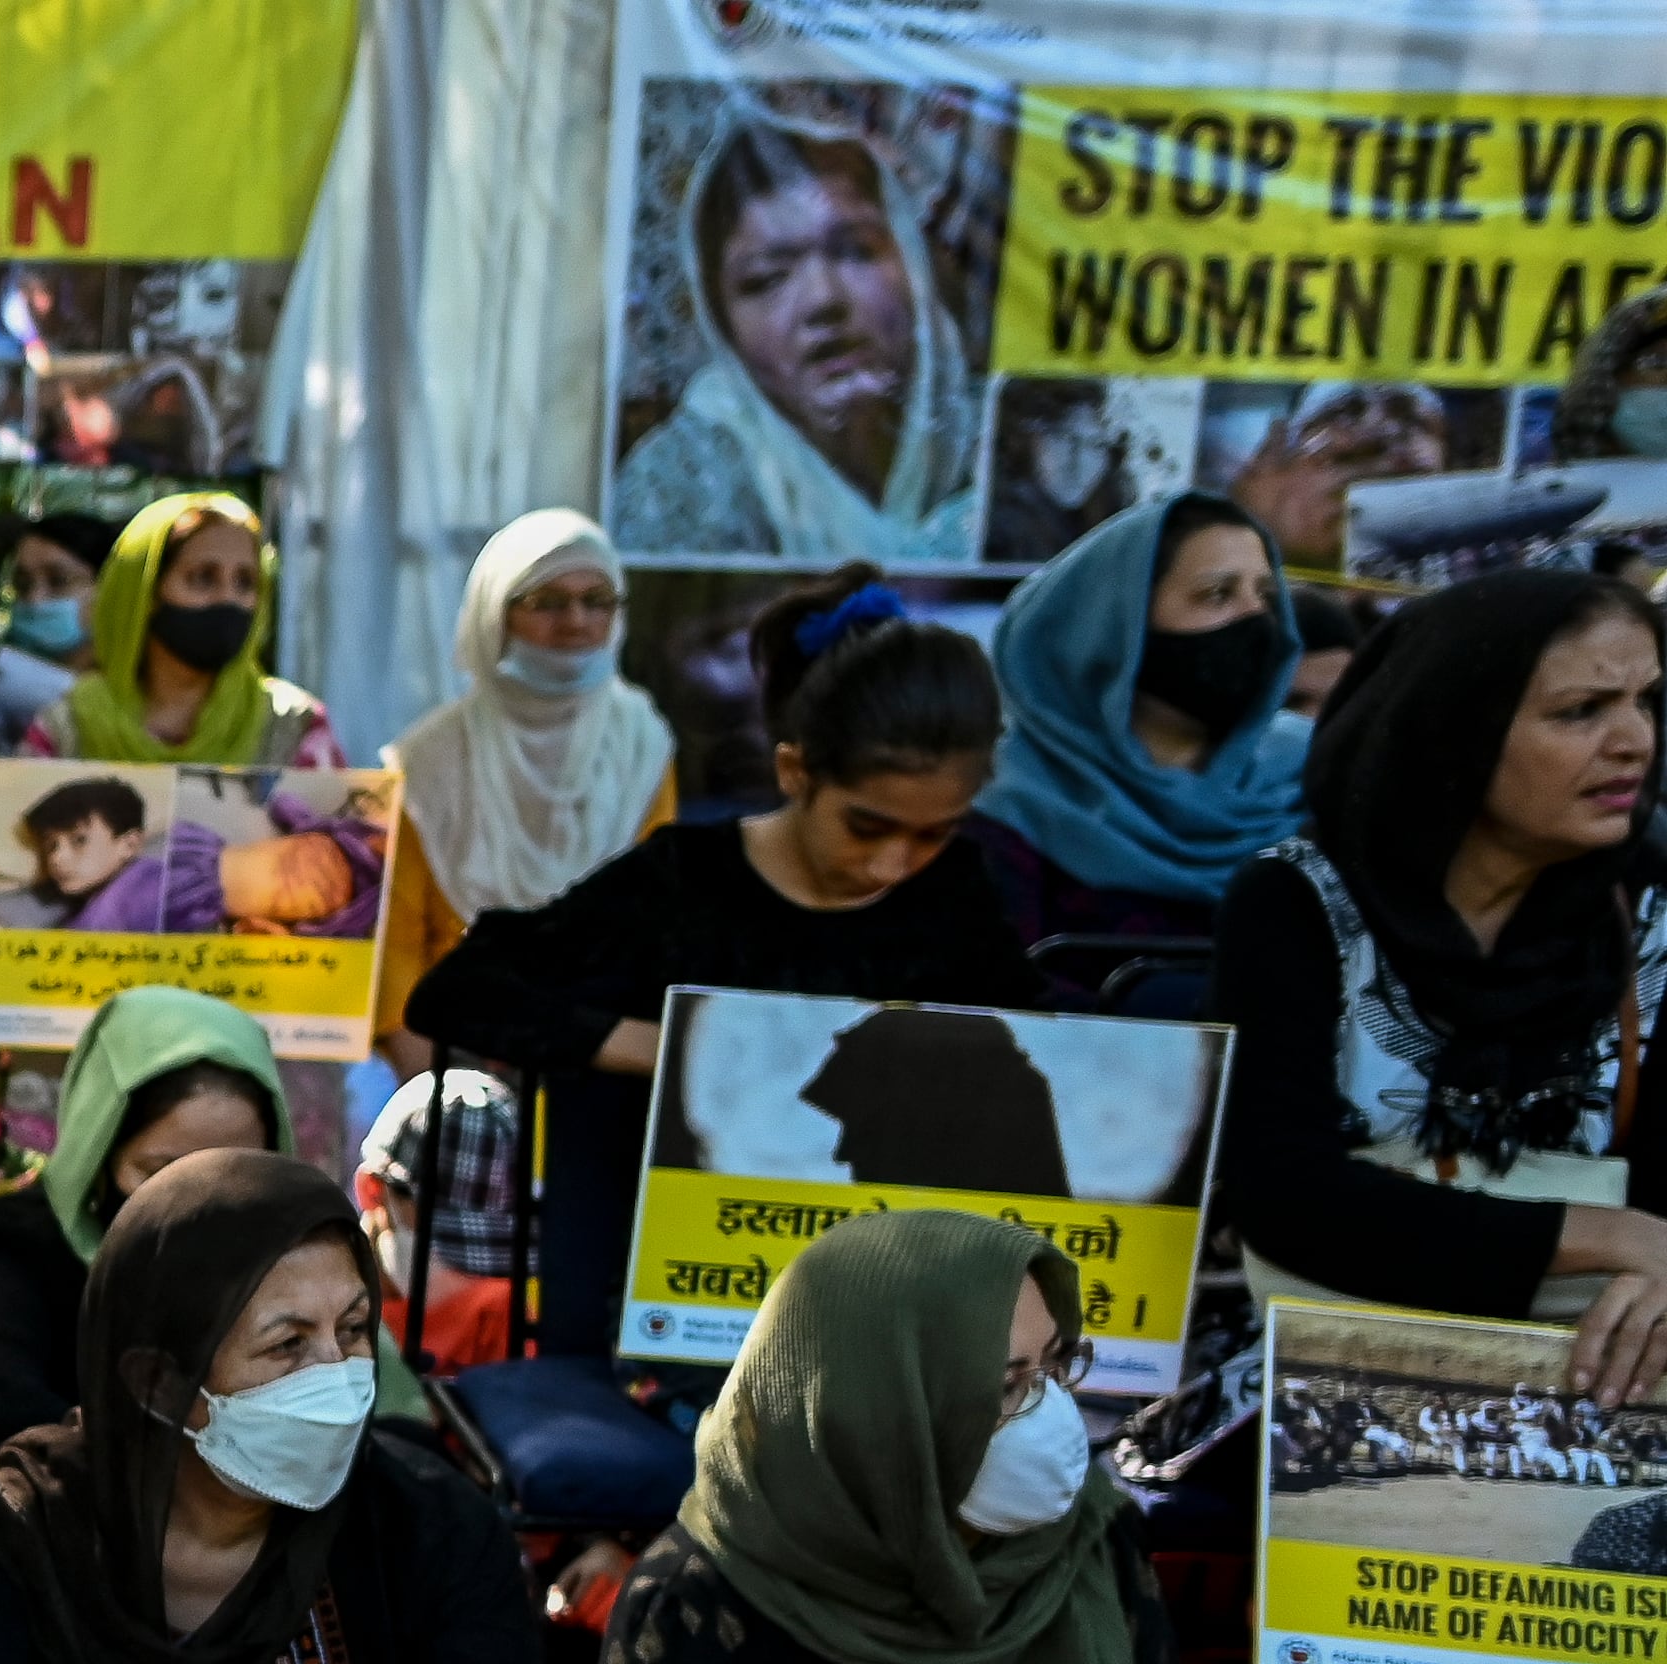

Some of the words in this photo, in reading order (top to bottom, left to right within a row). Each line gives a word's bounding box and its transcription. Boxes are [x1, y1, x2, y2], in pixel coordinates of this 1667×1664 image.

[1061, 109, 1296, 220] STOP
[1324, 115, 1493, 226] THE
[1047, 246, 1389, 363] WOMEN
[1412, 257, 1517, 366] IN
[1066, 1214, 1123, 1264] को
[1357, 1556, 1441, 1596] STOP
[1448, 1566, 1617, 1614] DEFAMING
[1348, 1595, 1438, 1638] NAME
[1448, 1605, 1488, 1642] OF
[1496, 1611, 1660, 1662] ATROCITY
